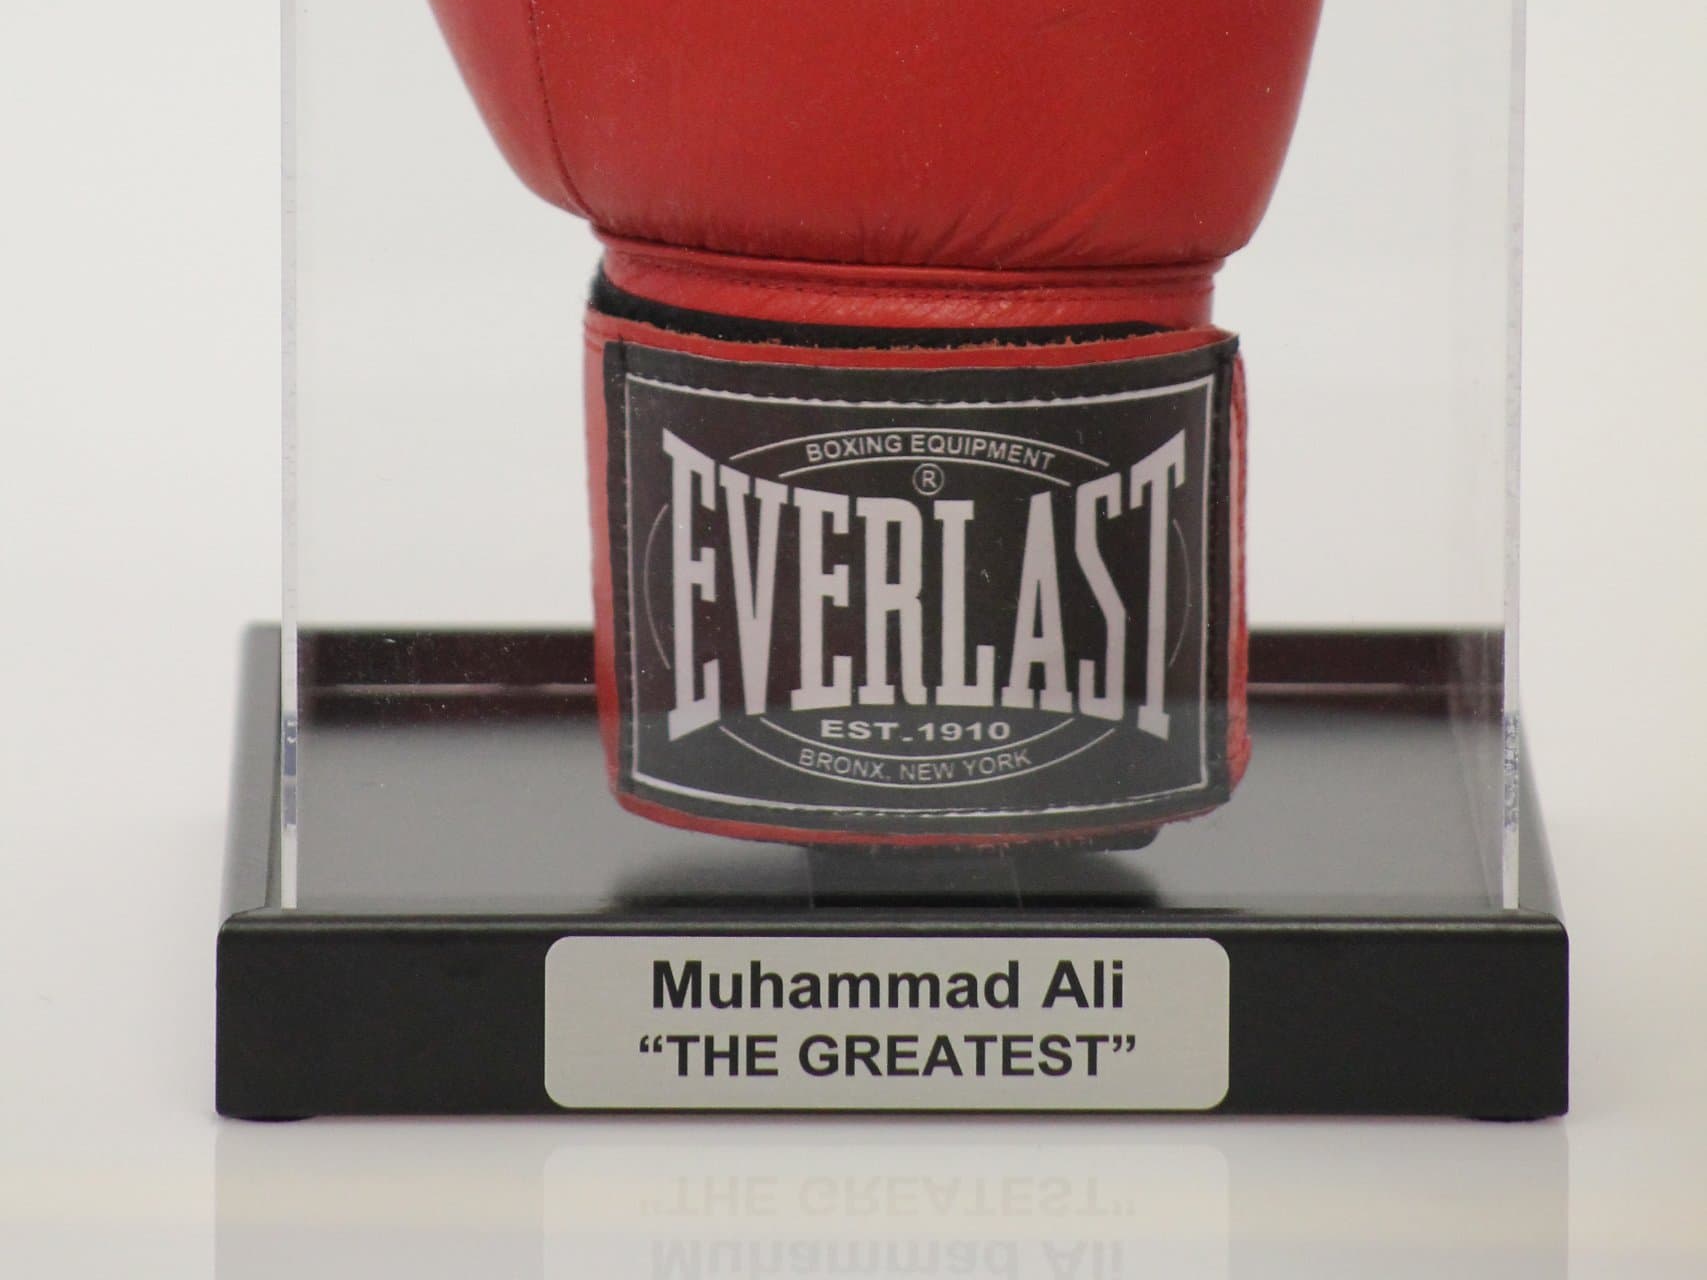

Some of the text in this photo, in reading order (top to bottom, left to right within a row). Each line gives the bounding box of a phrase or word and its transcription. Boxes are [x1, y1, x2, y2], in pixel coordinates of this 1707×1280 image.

[806, 434, 1056, 470] BOXING EQUIPMENT
[662, 428, 1185, 741] EVERLAST
[900, 763, 955, 782] NEW
[962, 748, 1032, 778] YORK
[652, 960, 1125, 1010] Muhammad Ali
